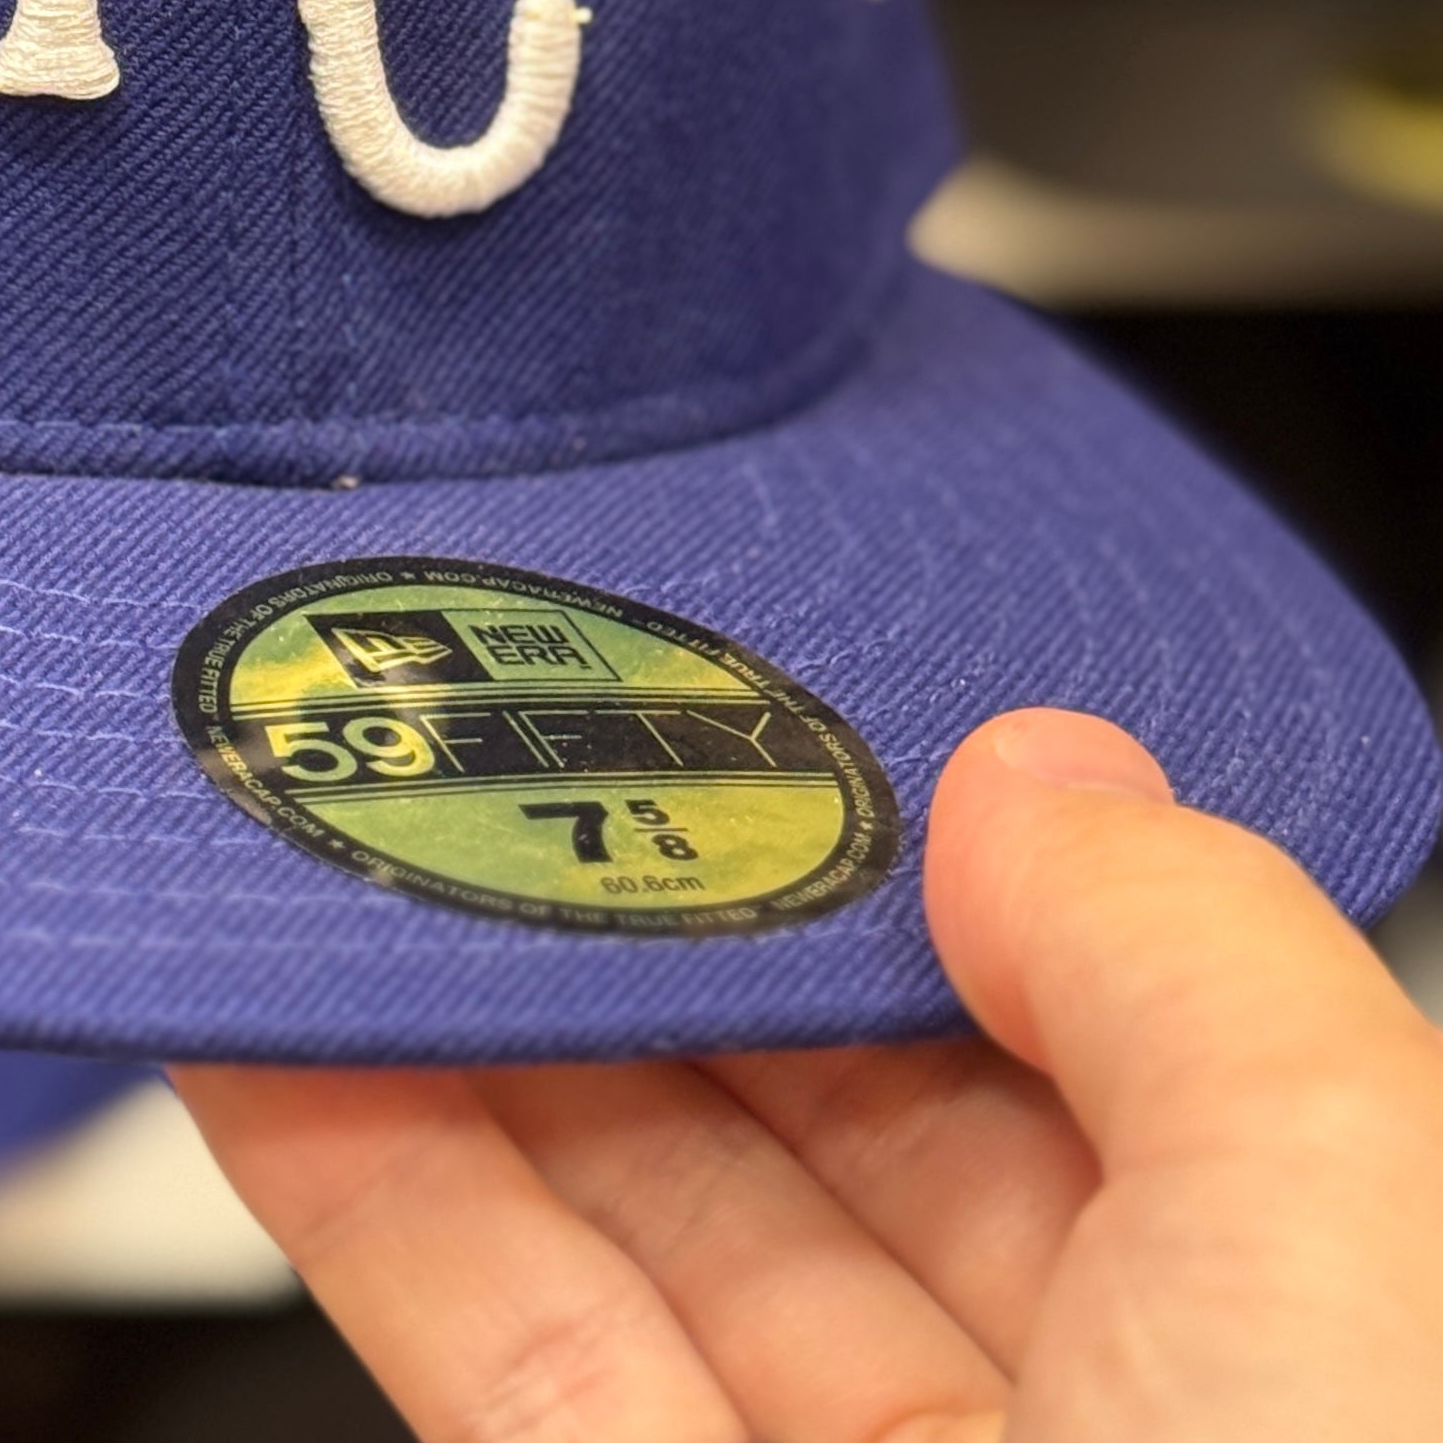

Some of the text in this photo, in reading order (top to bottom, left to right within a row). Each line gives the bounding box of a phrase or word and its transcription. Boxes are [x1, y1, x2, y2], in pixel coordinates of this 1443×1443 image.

[267, 571, 394, 609] ORIGINATORS
[250, 603, 274, 621] OF
[223, 616, 257, 640] THE
[467, 624, 570, 645] NEW
[204, 637, 237, 668] TRUE
[719, 652, 771, 689] TRUE
[517, 799, 614, 864] 7
[350, 849, 514, 911] ORIGINATORS
[600, 874, 706, 896] 60.6cm
